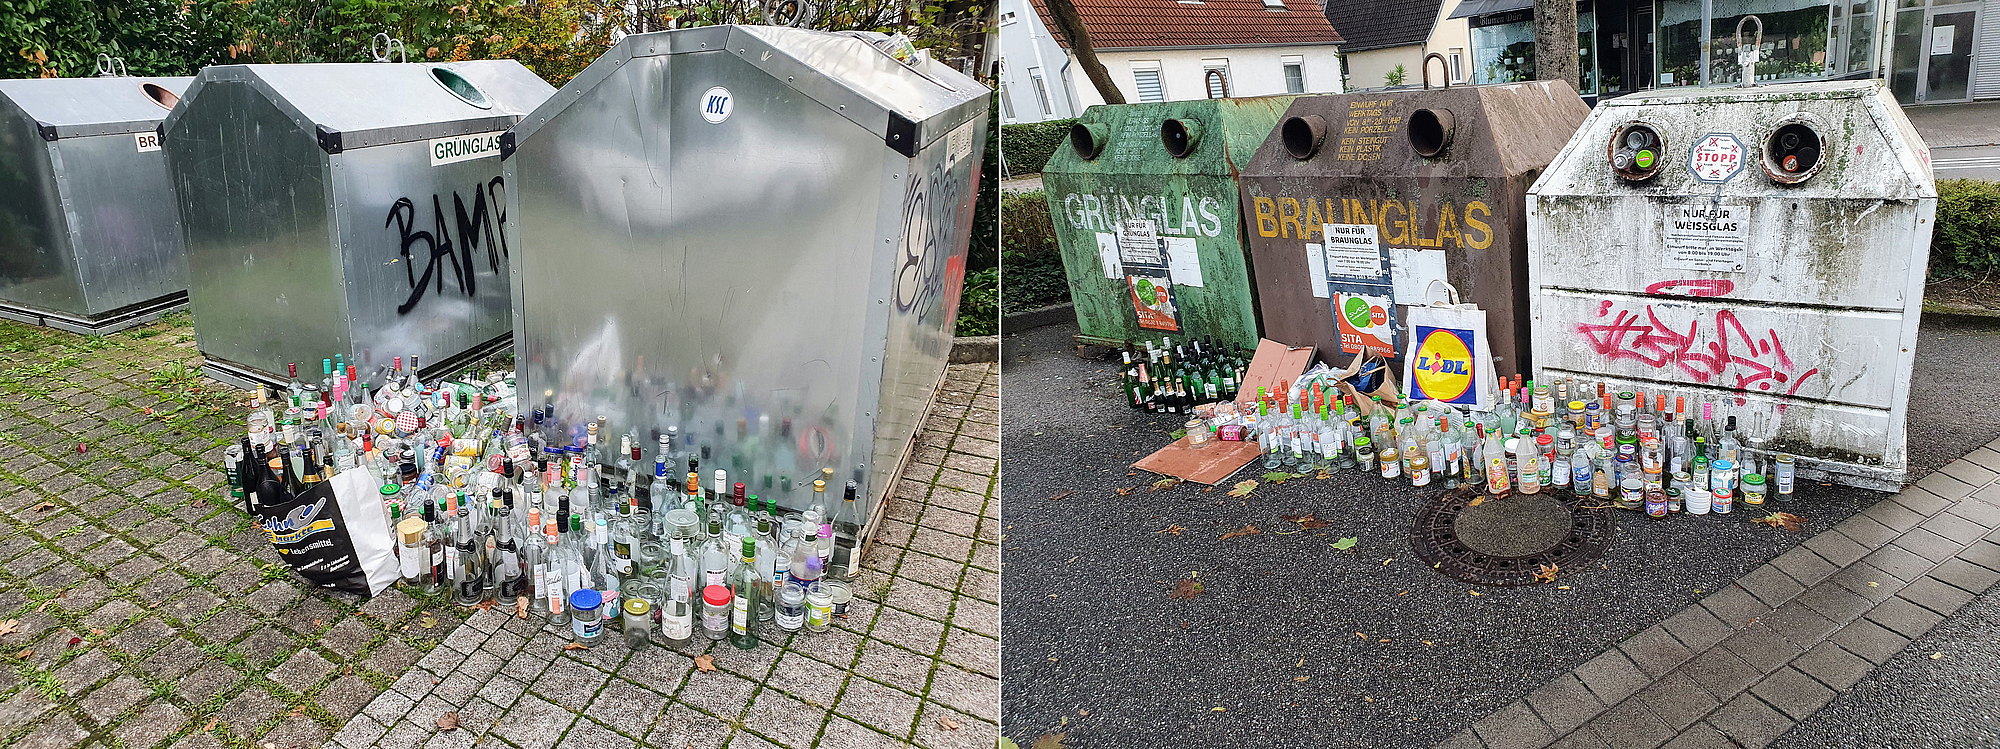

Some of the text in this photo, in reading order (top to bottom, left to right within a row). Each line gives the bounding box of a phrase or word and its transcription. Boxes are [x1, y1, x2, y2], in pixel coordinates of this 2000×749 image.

[706, 95, 728, 115] KSC
[434, 134, 501, 160] GRÜNGLAS
[1696, 152, 1736, 163] STOPP
[1064, 186, 1222, 238] GRÜNGLAS
[1683, 209, 1706, 218] NUR
[1253, 196, 1495, 250] BRAUNGLAS
[1674, 220, 1738, 232] WEISSGLAS
[1334, 225, 1366, 235] NUR FÜR
[1330, 236, 1373, 245] BRAUNGLAS
[1371, 311, 1385, 319] SITA
[1341, 333, 1363, 344] SITA
